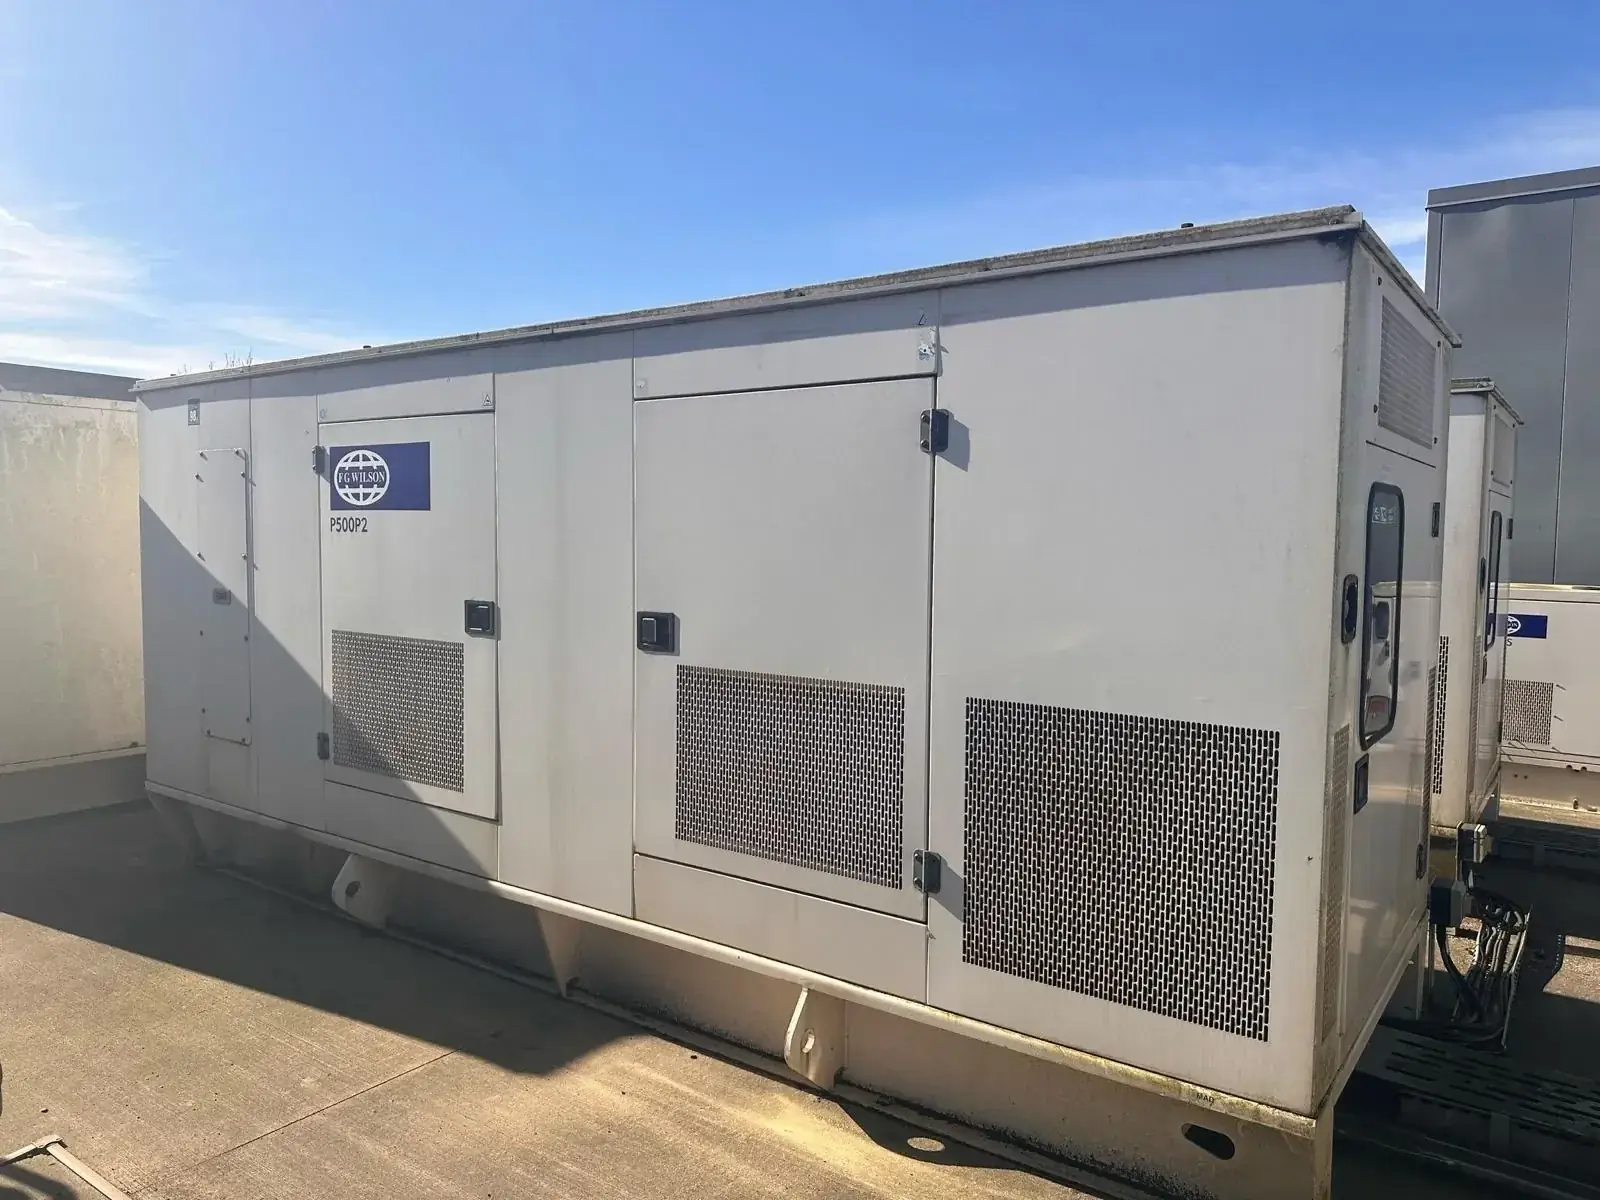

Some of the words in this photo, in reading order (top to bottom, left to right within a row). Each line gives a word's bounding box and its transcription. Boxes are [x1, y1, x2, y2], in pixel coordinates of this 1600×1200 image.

[338, 472, 350, 483] FG
[351, 471, 385, 483] WILSON
[330, 517, 368, 533] P500P2
